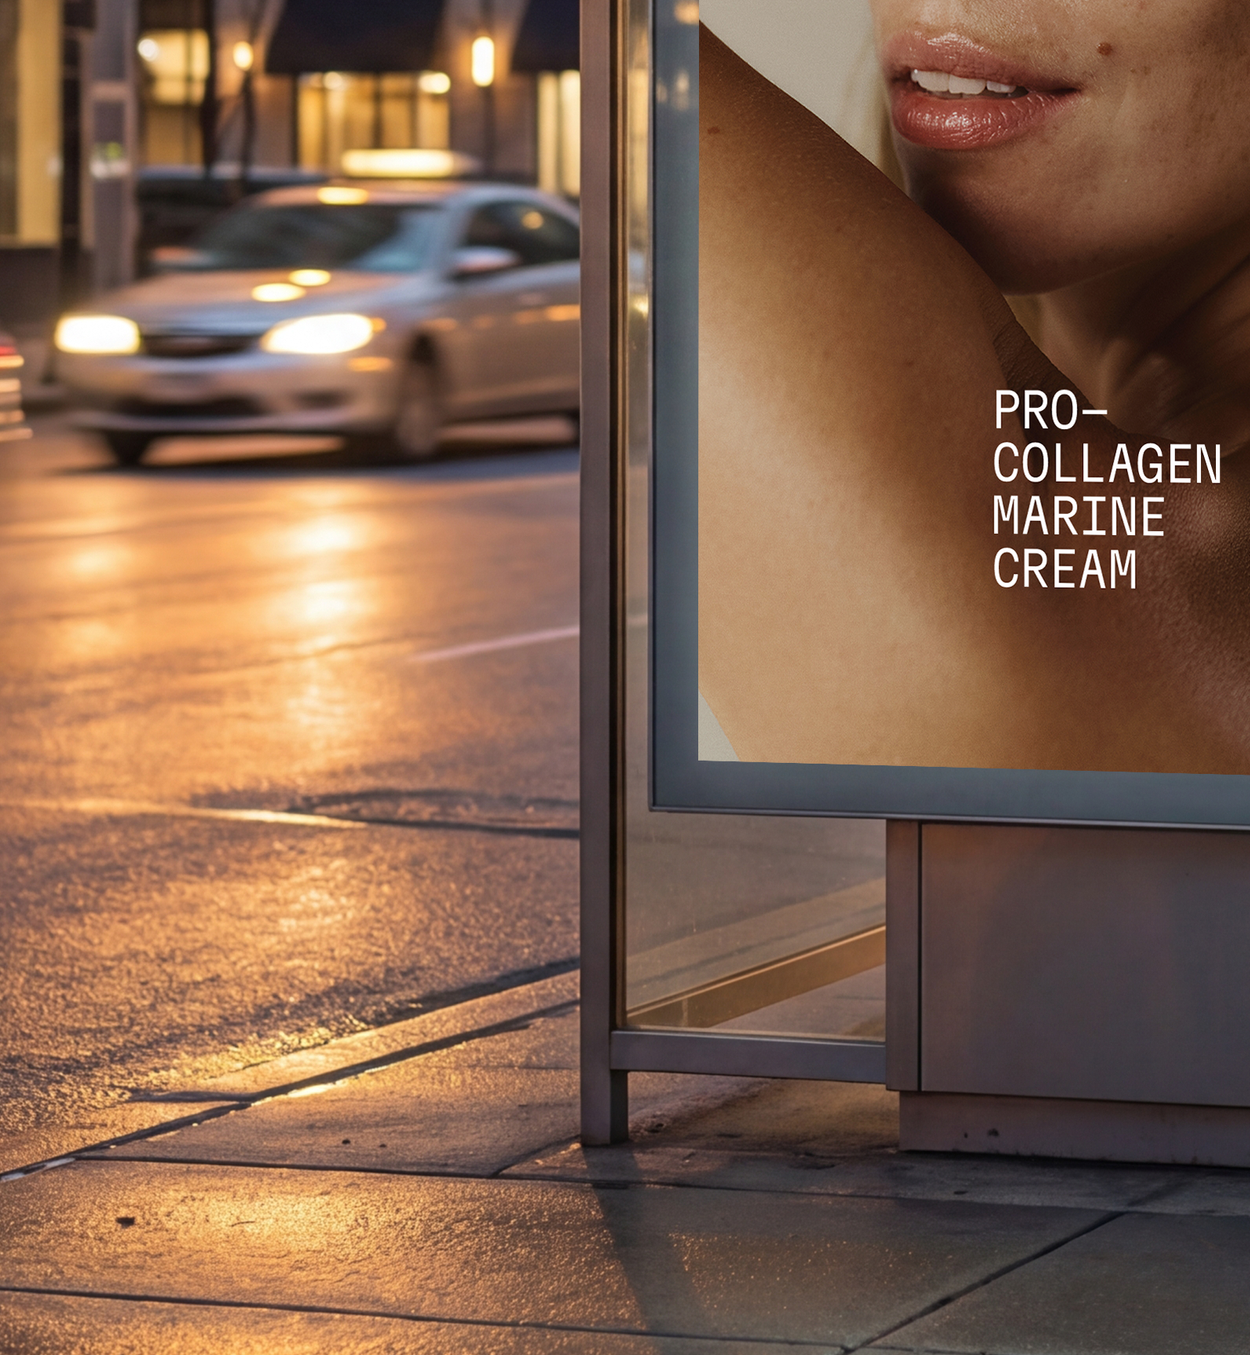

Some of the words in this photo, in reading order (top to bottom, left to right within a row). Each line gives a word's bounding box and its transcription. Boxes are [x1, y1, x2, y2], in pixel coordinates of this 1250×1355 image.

[994, 441, 1221, 484] COLLAGEN
[993, 495, 1165, 537] MARINE
[994, 547, 1136, 589] CREAM
